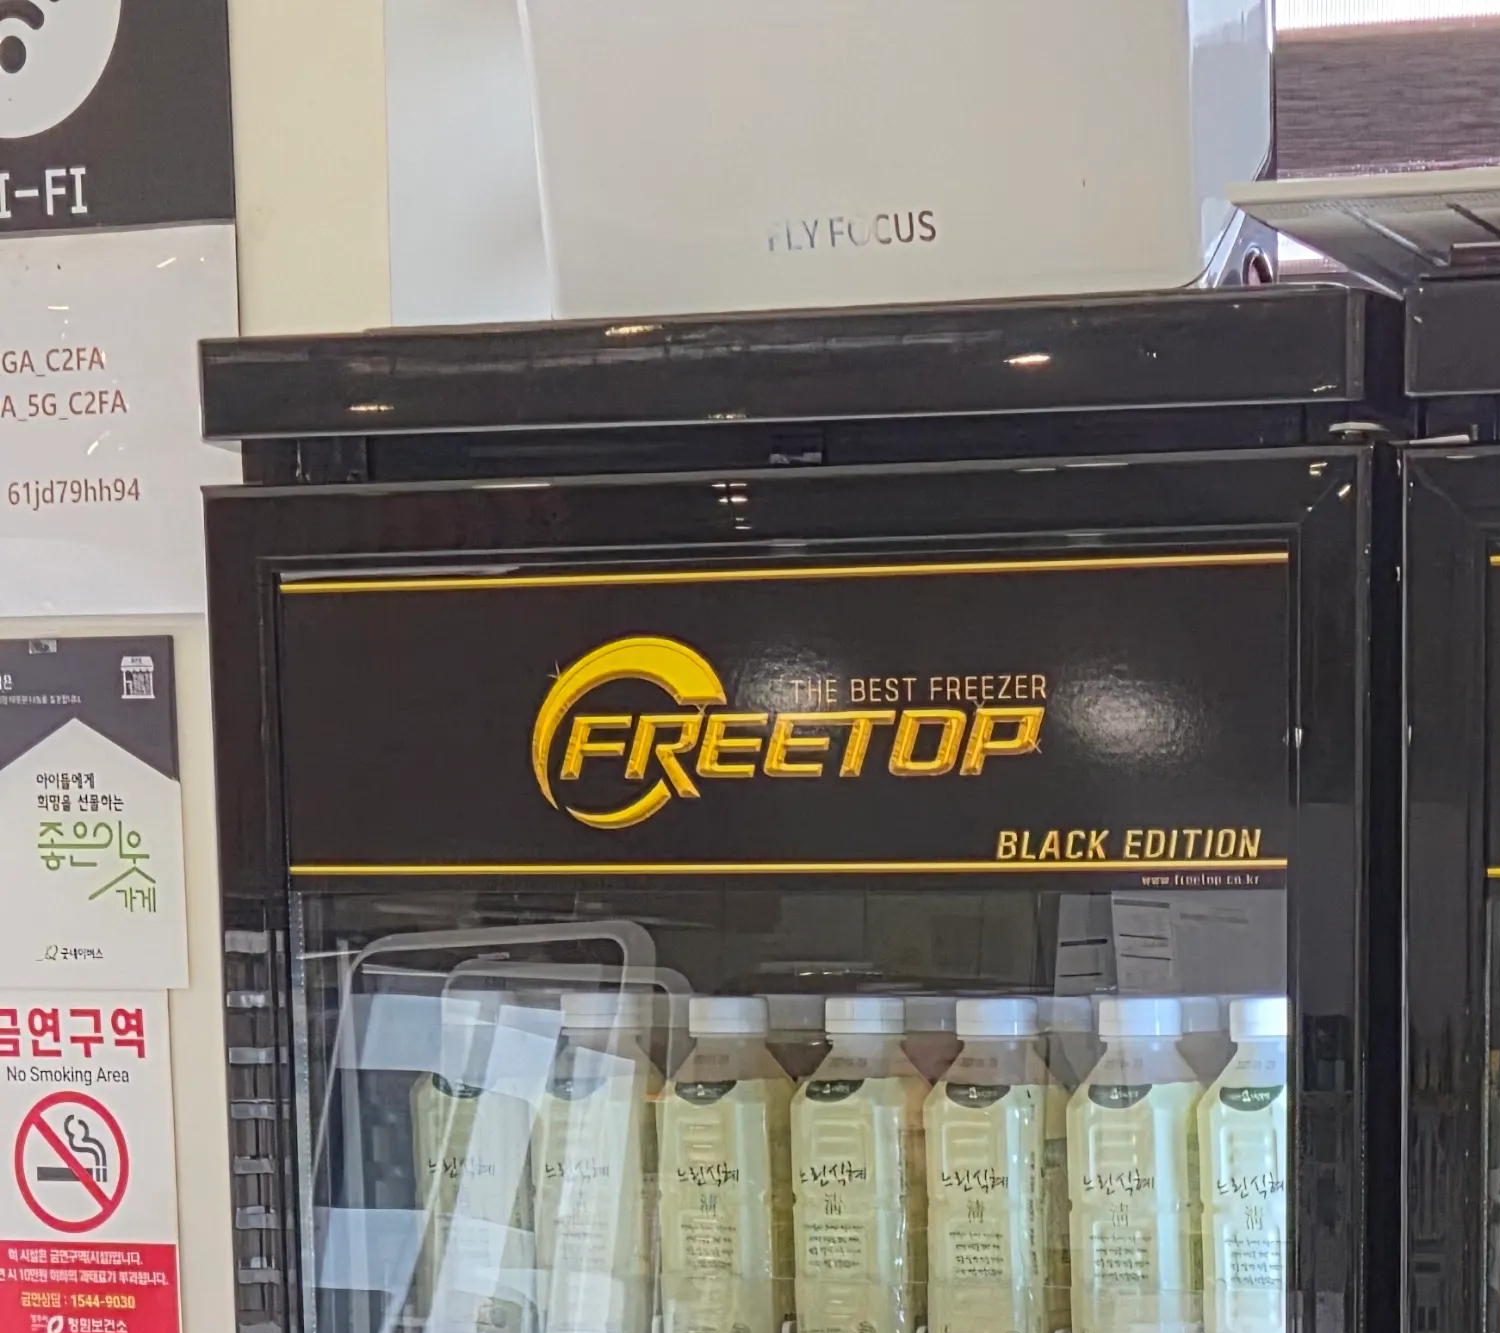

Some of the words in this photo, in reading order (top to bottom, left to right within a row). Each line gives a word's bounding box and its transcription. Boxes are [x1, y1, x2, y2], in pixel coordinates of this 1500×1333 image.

[8, 478, 141, 511] 61jd79hh94
[791, 678, 839, 705] THE
[850, 677, 918, 703] BEST
[929, 674, 1048, 702] FREEZER
[560, 706, 1046, 799] FREETOP
[36, 772, 95, 790] 아이들에게
[37, 793, 71, 812] 희망을
[78, 793, 124, 812] 선물하는
[996, 829, 1110, 860] BLACK
[1123, 828, 1262, 860] EDITION
[116, 885, 157, 913] 가게
[0, 1007, 147, 1059] 금연구역
[6, 1066, 27, 1082] No
[30, 1066, 93, 1086] Smoking
[97, 1067, 130, 1084] Area
[70, 1294, 137, 1309] 1544-9030
